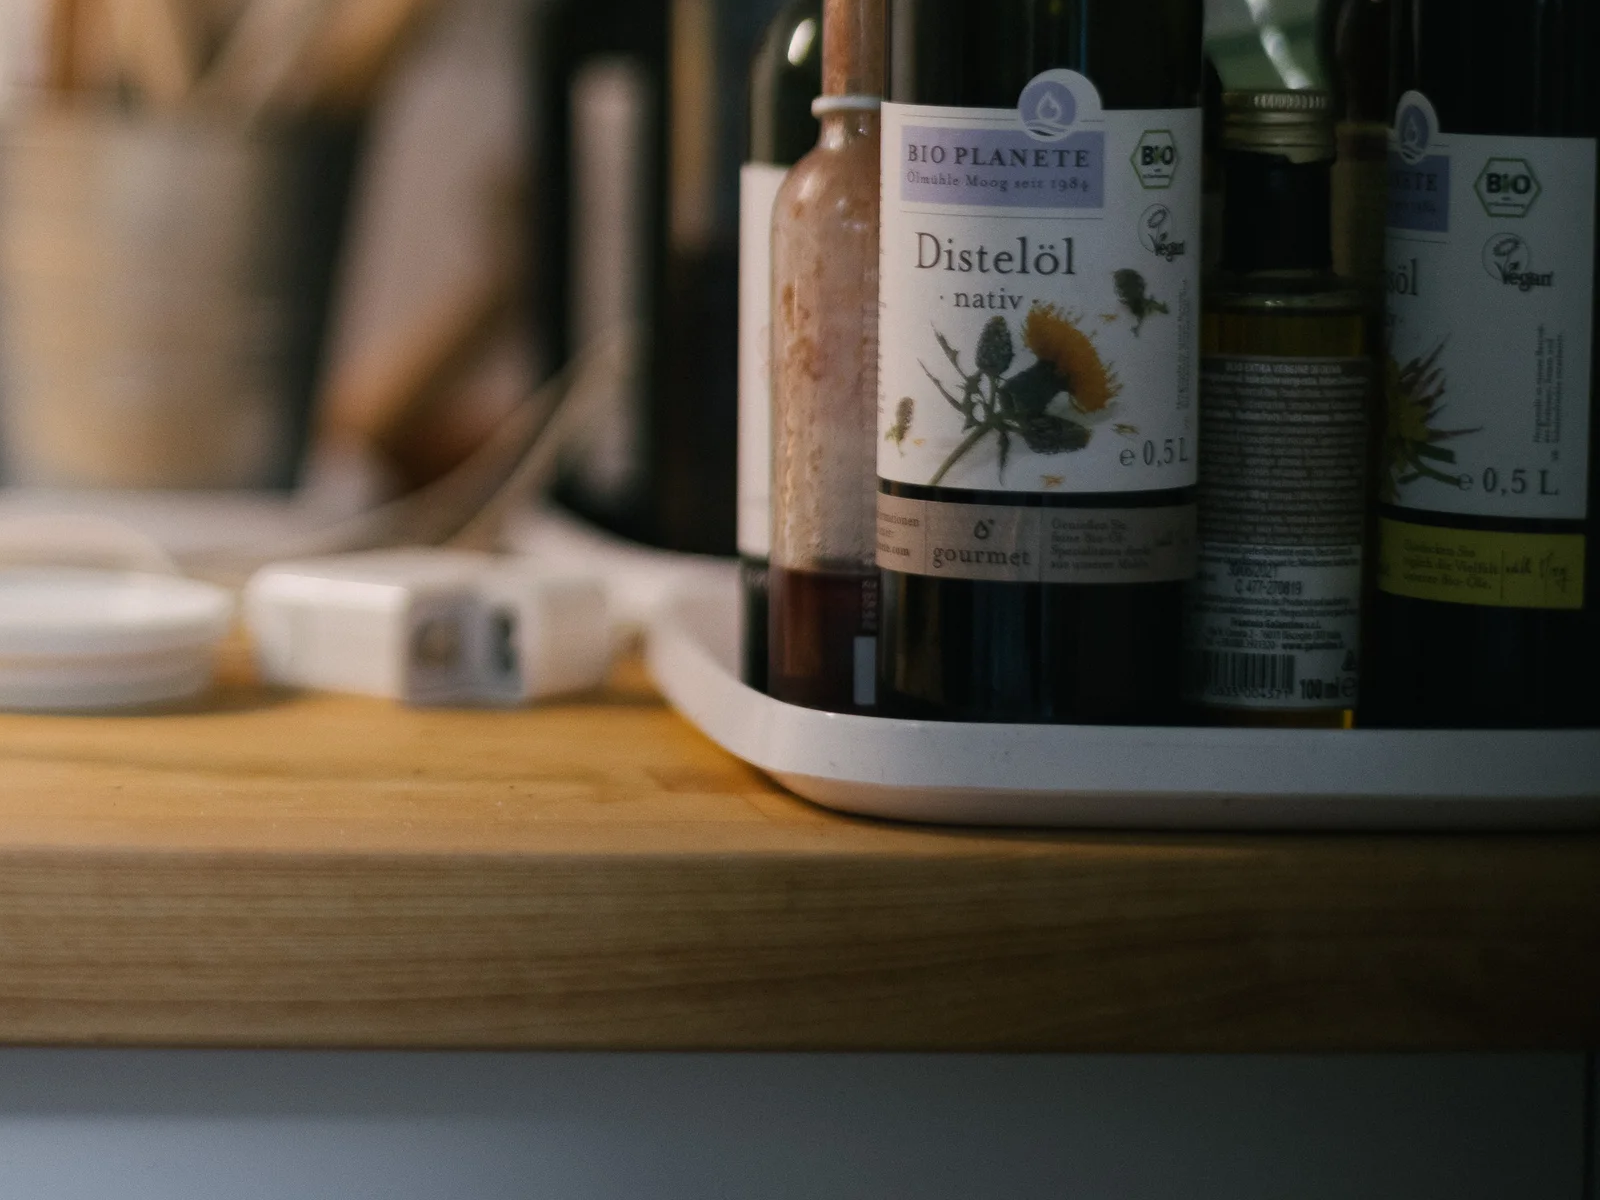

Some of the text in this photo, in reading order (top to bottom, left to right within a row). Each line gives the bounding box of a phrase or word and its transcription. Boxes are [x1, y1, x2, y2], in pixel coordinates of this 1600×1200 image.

[907, 144, 1091, 168] BIO PLANETE
[965, 174, 1009, 193] Moog
[913, 231, 1077, 276] Distelöl
[953, 288, 1024, 311] nativ
[1482, 466, 1528, 497] 0,5
[1537, 468, 1560, 496] L
[932, 546, 1032, 570] gourmet
